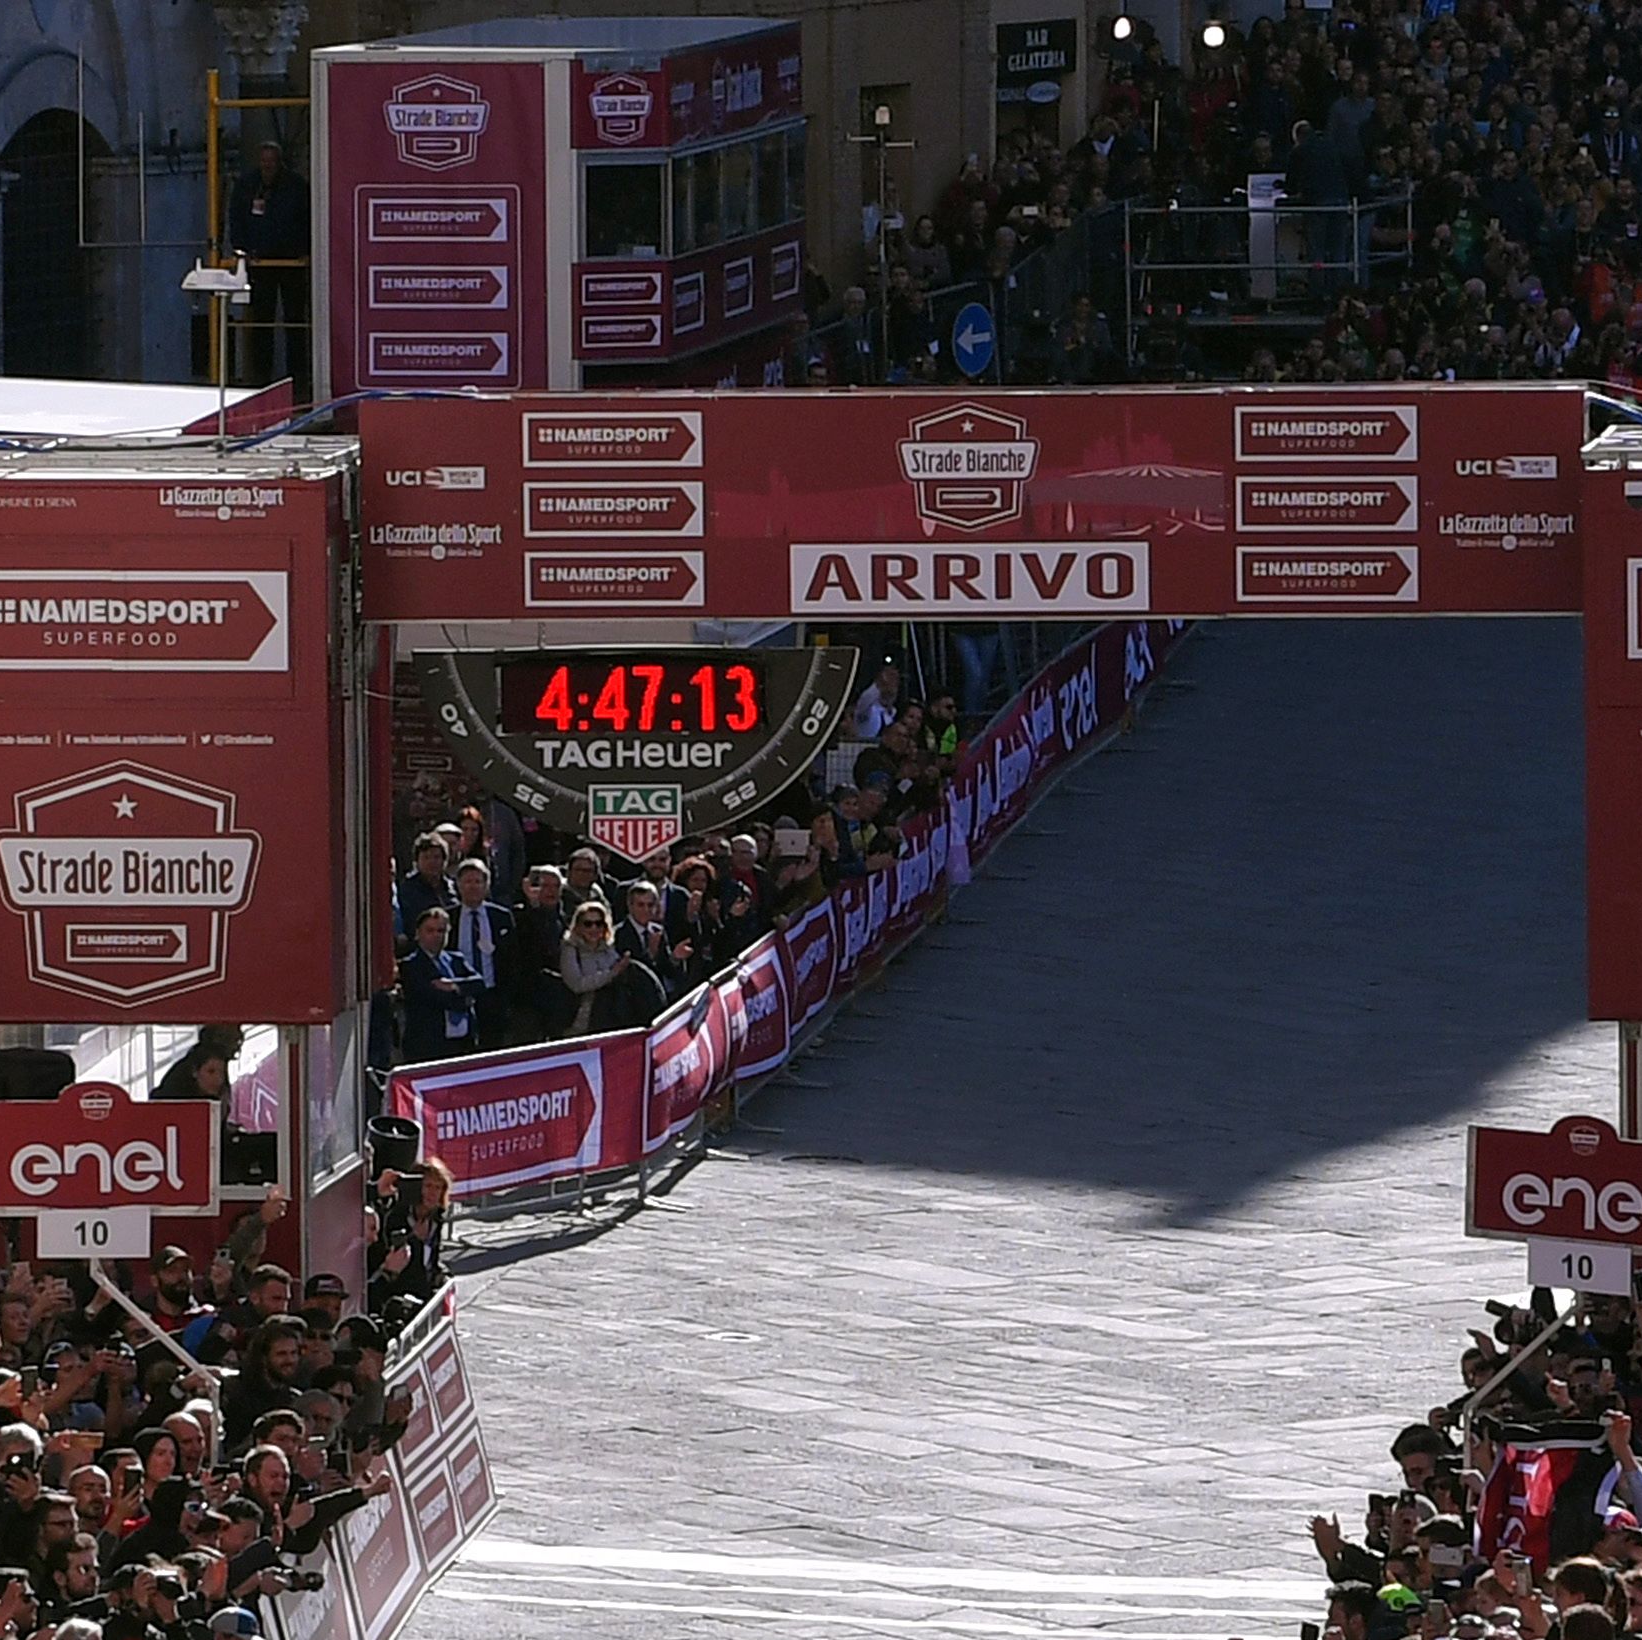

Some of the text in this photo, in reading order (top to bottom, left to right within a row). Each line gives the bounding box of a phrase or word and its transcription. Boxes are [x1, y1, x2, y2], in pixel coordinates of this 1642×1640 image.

[1025, 28, 1048, 47] BAR
[1008, 50, 1066, 72] GELATERIA
[395, 110, 479, 128] Strade Bianche
[392, 211, 481, 222] NAMEDSPORT
[393, 278, 482, 289] NAMEDSPORT
[393, 345, 482, 356] NAMEDSPORT
[555, 428, 670, 442] NAMEDSPORT
[1267, 422, 1385, 436] NAMEDSPORT
[567, 445, 642, 454] SUPERFOOD
[1280, 439, 1356, 448] SUPERFOOD
[911, 449, 1026, 473] Strade Bianche
[1456, 460, 1492, 475] UCI
[386, 471, 421, 486] UCI
[35, 497, 44, 508] DI
[46, 497, 77, 508] SIENA
[160, 487, 284, 508] La Gazzetta dello Sport
[556, 498, 670, 512] NAMEDSPORT
[1268, 492, 1385, 506] NAMEDSPORT
[568, 515, 643, 524] SUPERFOOD
[1281, 509, 1357, 518] SUPERFOOD
[1439, 513, 1574, 537] La Gazzetta dello Sport
[370, 524, 502, 547] La Gazzetta dello Sport
[556, 567, 671, 582] NAMEDSPORT
[804, 552, 1135, 600] ARRIVO
[1268, 562, 1386, 576] NAMEDSPORT
[569, 585, 644, 593] SUPERFOOD
[1281, 580, 1357, 588] SUPERFOOD
[20, 599, 228, 624] NAMEDSPORT
[43, 631, 178, 646] SUPERFOOD
[535, 665, 758, 732] 4:47:13
[596, 790, 674, 813] TAG
[595, 820, 675, 857] HEUER
[18, 850, 234, 894] Strade Bianche
[87, 935, 168, 946] NAMEDSPORT
[456, 1087, 573, 1140] NAMEDSPORT
[470, 1133, 545, 1162] SUPERFOOD
[10, 1125, 185, 1196] enel
[74, 1220, 109, 1246] 10
[1561, 1254, 1593, 1280] 10
